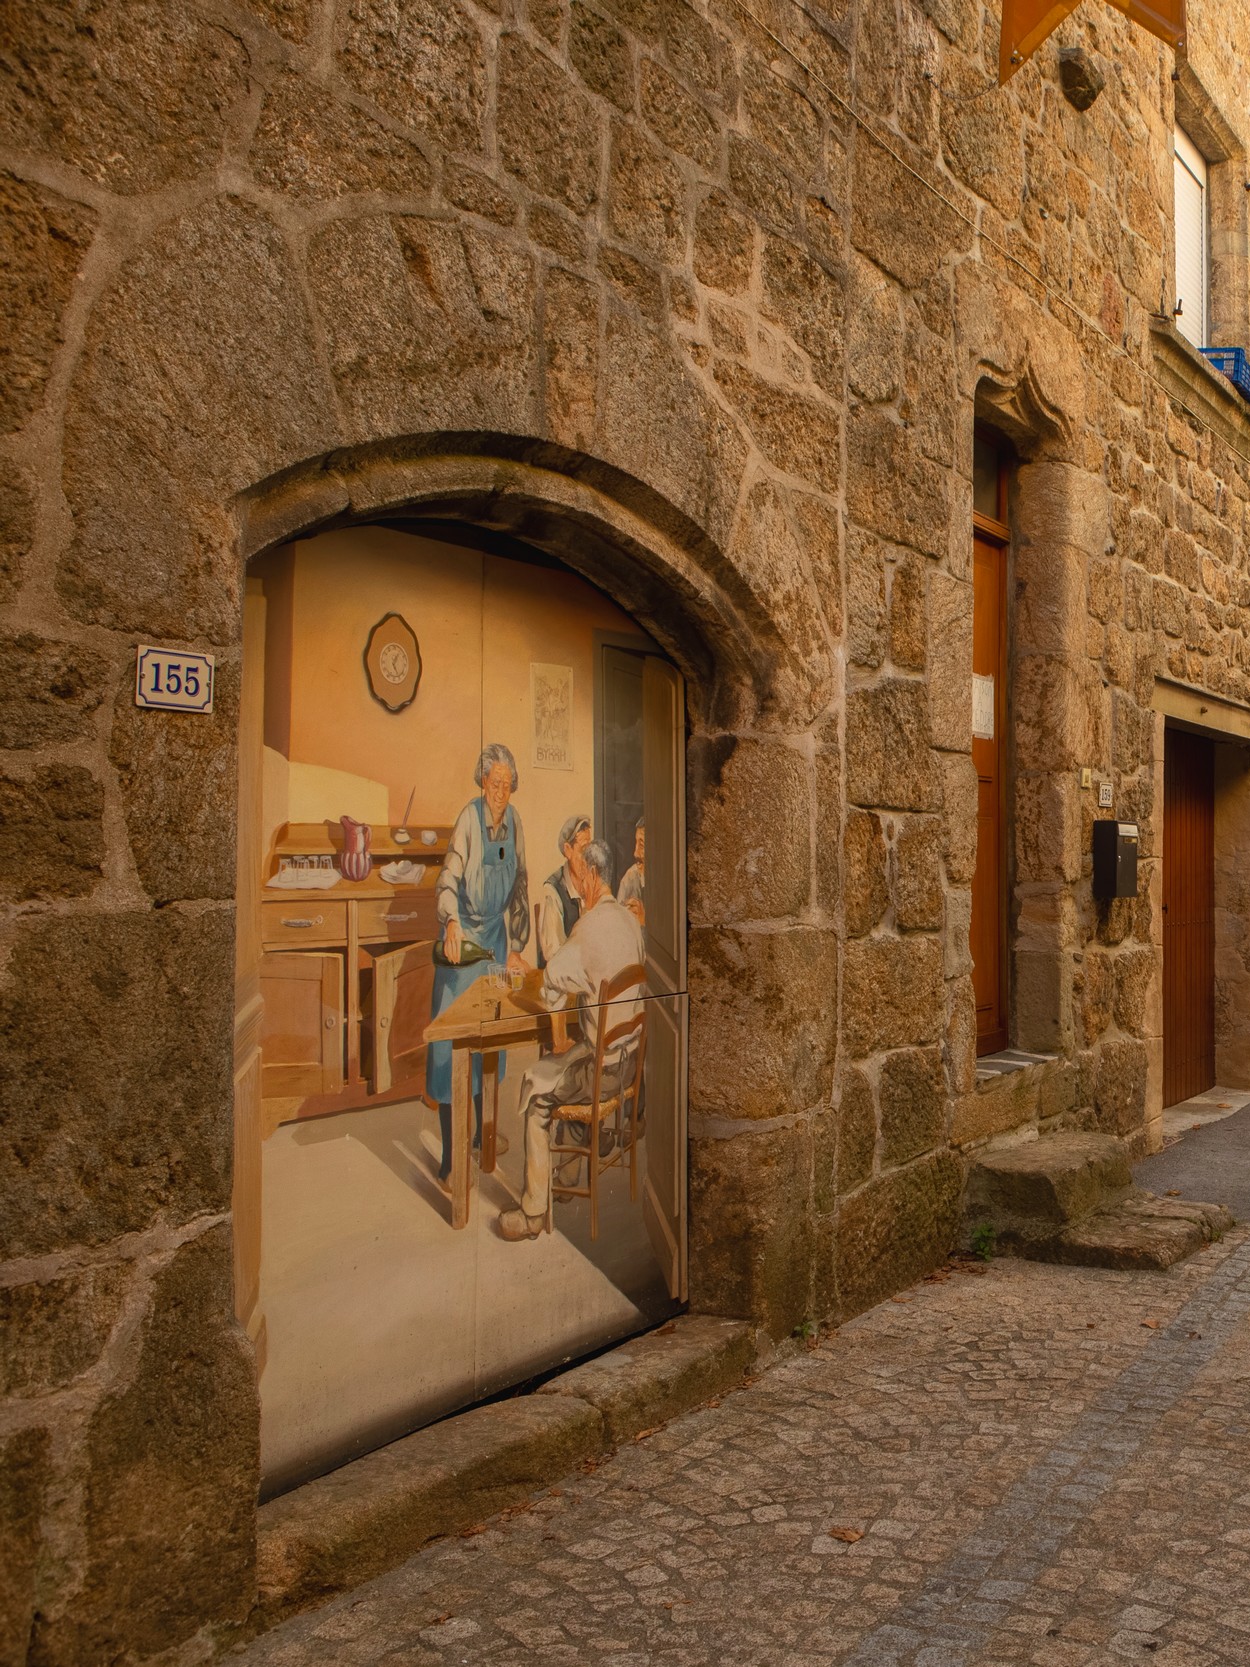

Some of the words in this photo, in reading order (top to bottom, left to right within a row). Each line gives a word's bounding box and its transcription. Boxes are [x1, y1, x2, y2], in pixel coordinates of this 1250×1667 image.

[151, 663, 200, 697] 155
[537, 747, 566, 762] BYRRH
[1101, 788, 1110, 801] 159
